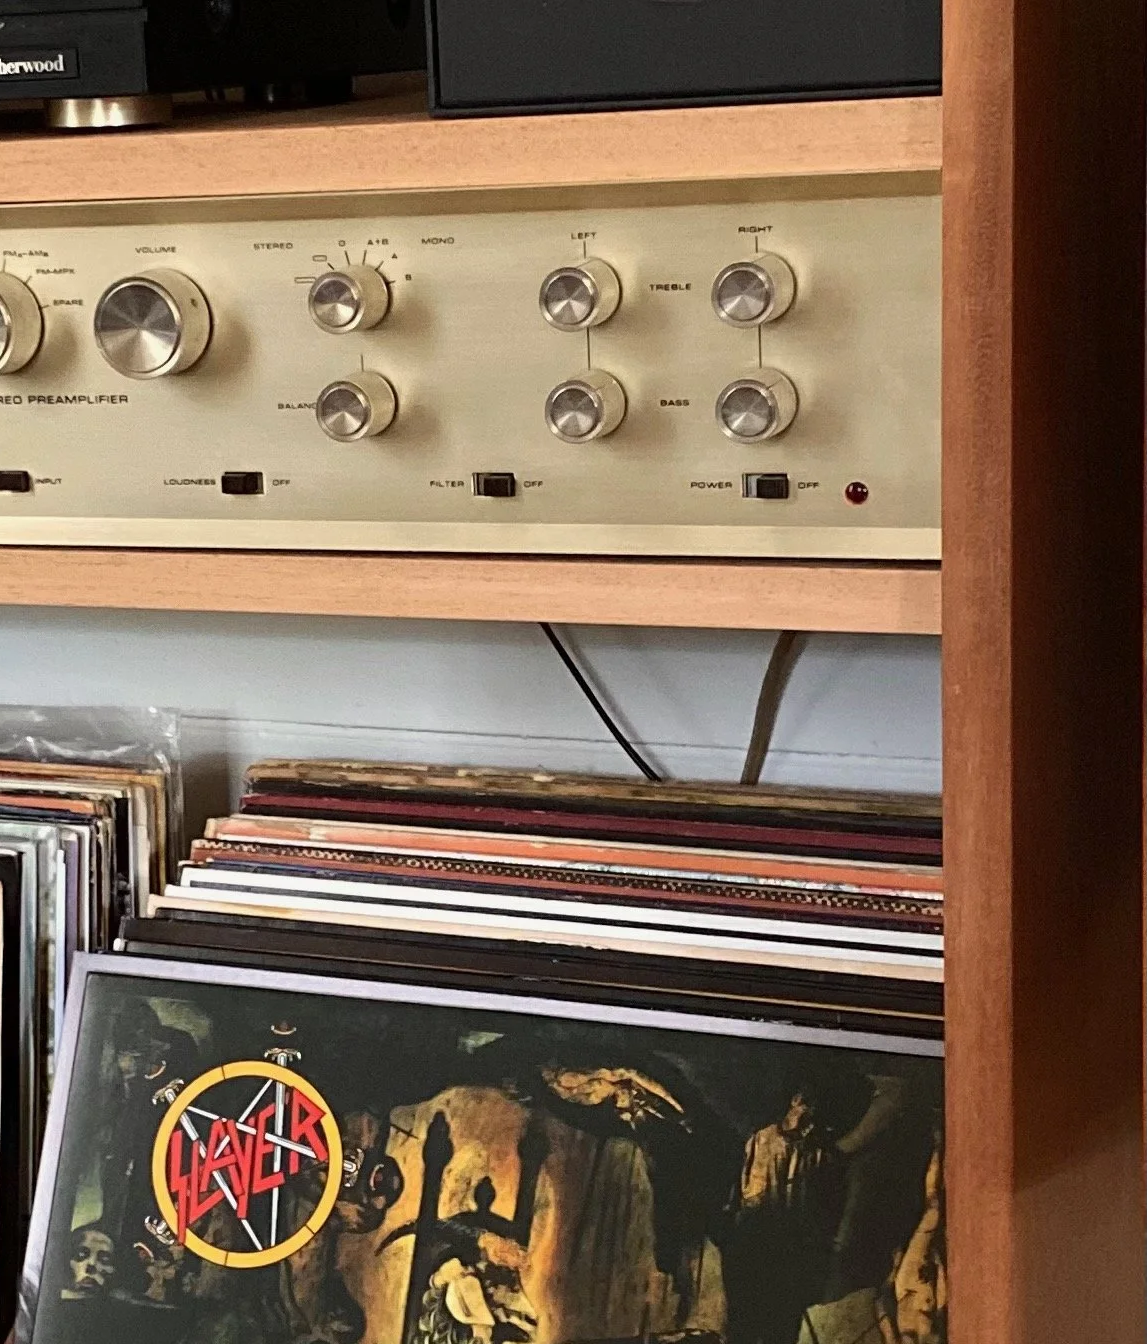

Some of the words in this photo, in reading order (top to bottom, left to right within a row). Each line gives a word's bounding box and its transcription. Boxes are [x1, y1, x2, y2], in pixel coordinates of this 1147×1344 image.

[737, 225, 774, 234] RIGHT
[570, 231, 597, 240] LEFT
[420, 236, 455, 245] MONO
[134, 246, 177, 254] VOLUME
[253, 242, 294, 251] STEREO
[649, 282, 692, 292] TREBLE
[28, 394, 129, 405] PREAMPLIFIER
[659, 399, 690, 407] BASS
[277, 402, 317, 410] BALANC
[163, 478, 217, 486] LOUDNESS
[271, 478, 291, 487] OFF
[429, 480, 465, 488] FILTER
[523, 480, 544, 488] OFF
[690, 481, 733, 489] POWER
[797, 481, 820, 490] OFF
[169, 1085, 329, 1247] SLAYER
